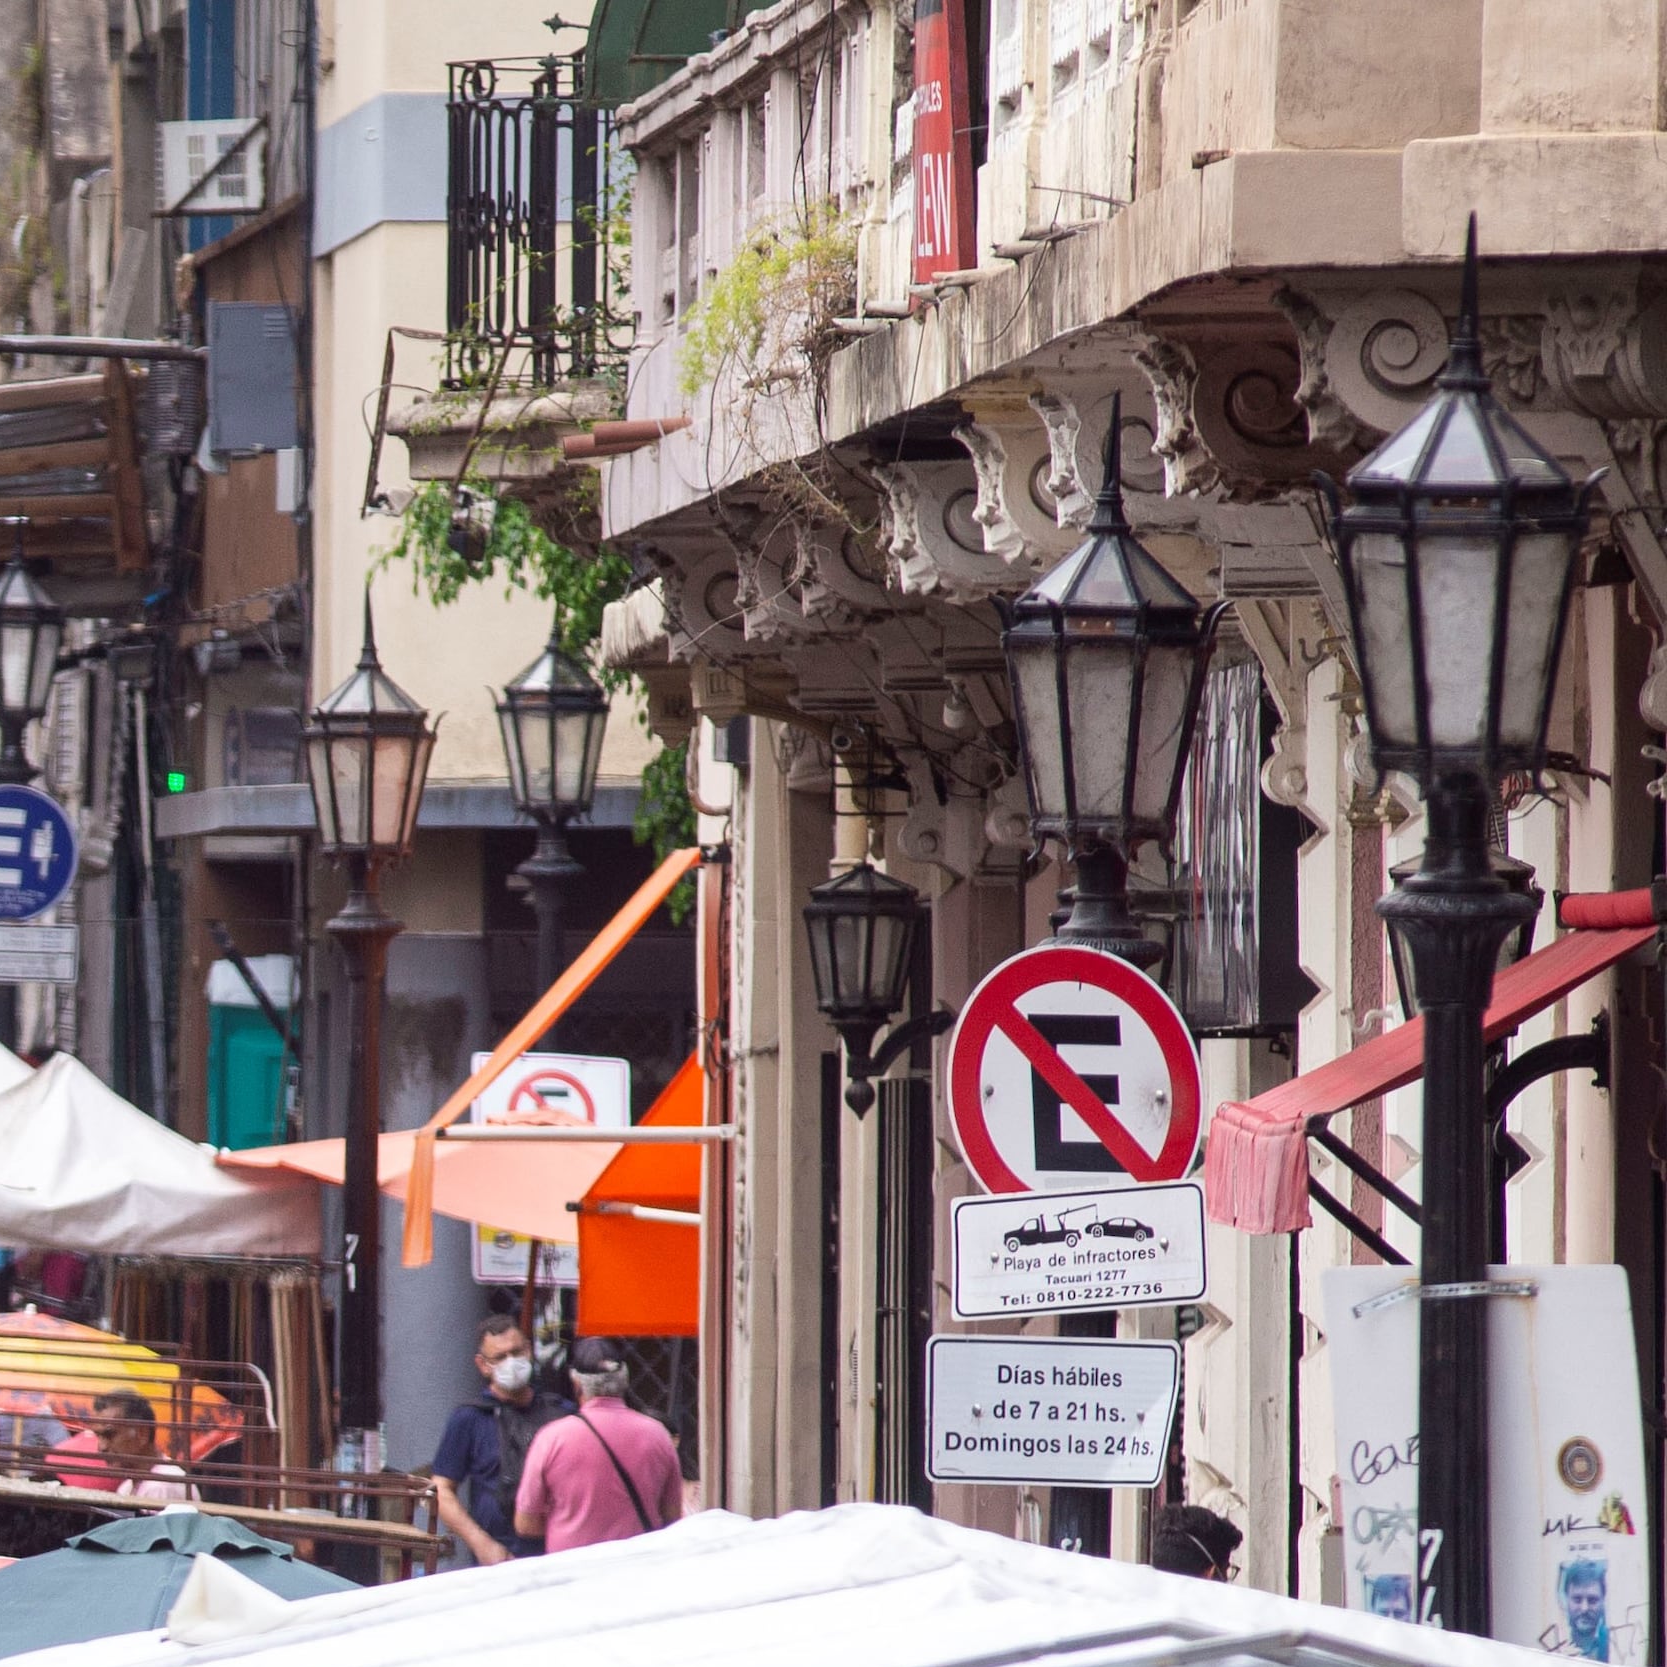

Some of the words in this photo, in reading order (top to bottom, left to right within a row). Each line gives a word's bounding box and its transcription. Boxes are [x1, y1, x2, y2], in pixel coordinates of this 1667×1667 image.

[1028, 1013, 1130, 1173] E
[1003, 1256, 1041, 1272] Playa
[1048, 1252, 1066, 1267] de
[1073, 1247, 1156, 1266] infractores
[1097, 1269, 1126, 1282] 1277
[1000, 1294, 1031, 1307] Tel:
[1036, 1282, 1163, 1304] 0810-222-7736
[997, 1364, 1045, 1385] Días
[1052, 1365, 1122, 1388] hábiles
[993, 1399, 1022, 1419] de
[1029, 1400, 1041, 1420] 7
[1048, 1406, 1060, 1420] a
[1066, 1401, 1088, 1421] 21
[1095, 1402, 1126, 1423] hs.
[945, 1431, 1061, 1457] Domingos
[1068, 1434, 1098, 1455] las
[1104, 1436, 1127, 1456] 24
[1130, 1436, 1154, 1456] hs.
